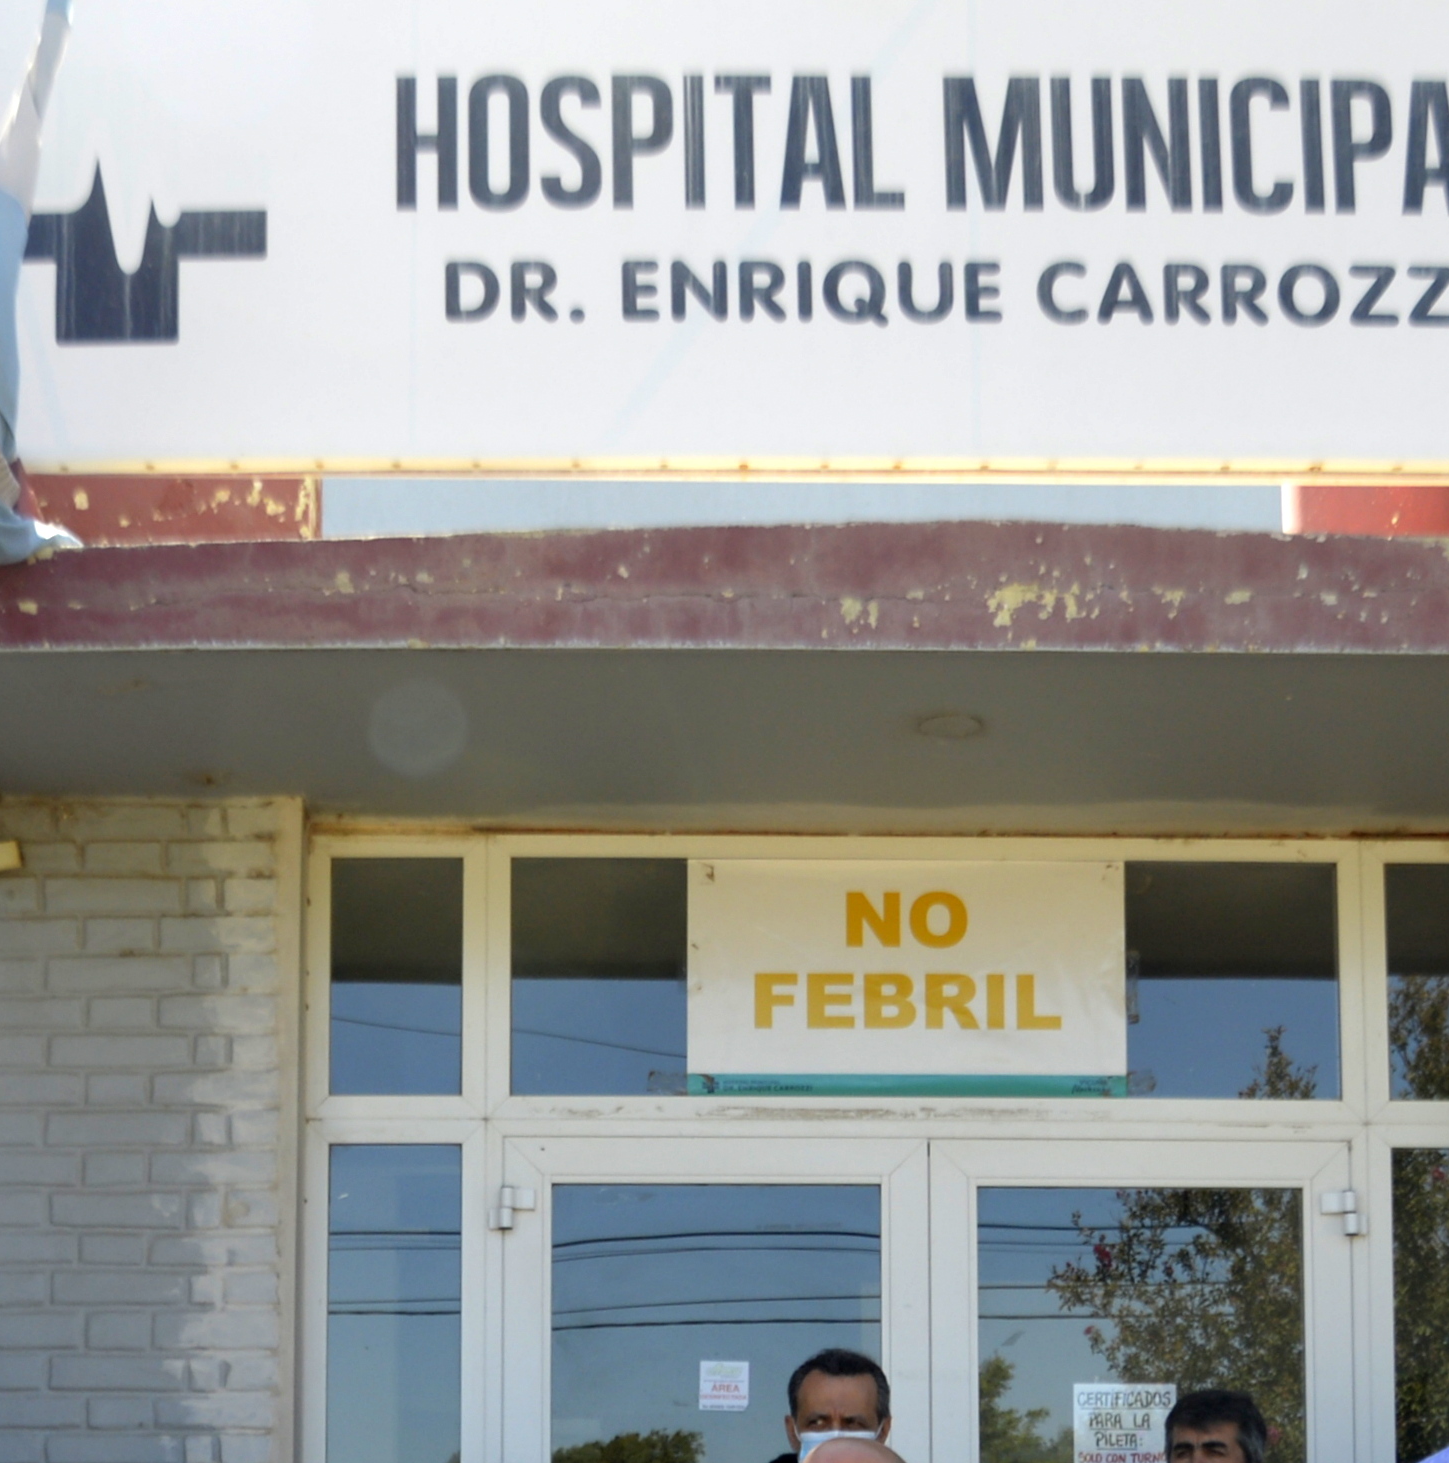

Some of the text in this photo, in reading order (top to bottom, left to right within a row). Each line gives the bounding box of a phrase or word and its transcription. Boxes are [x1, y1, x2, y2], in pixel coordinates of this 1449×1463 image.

[395, 74, 905, 213] HOSPITAL
[443, 260, 586, 325] DR.
[622, 260, 1003, 328] ENRIQUE
[845, 890, 968, 949] NO
[753, 972, 1062, 1030] FEBRIL
[1089, 1412, 1150, 1429] PARA LA
[1078, 1452, 1103, 1463] SOLO
[1106, 1452, 1127, 1463] CON
